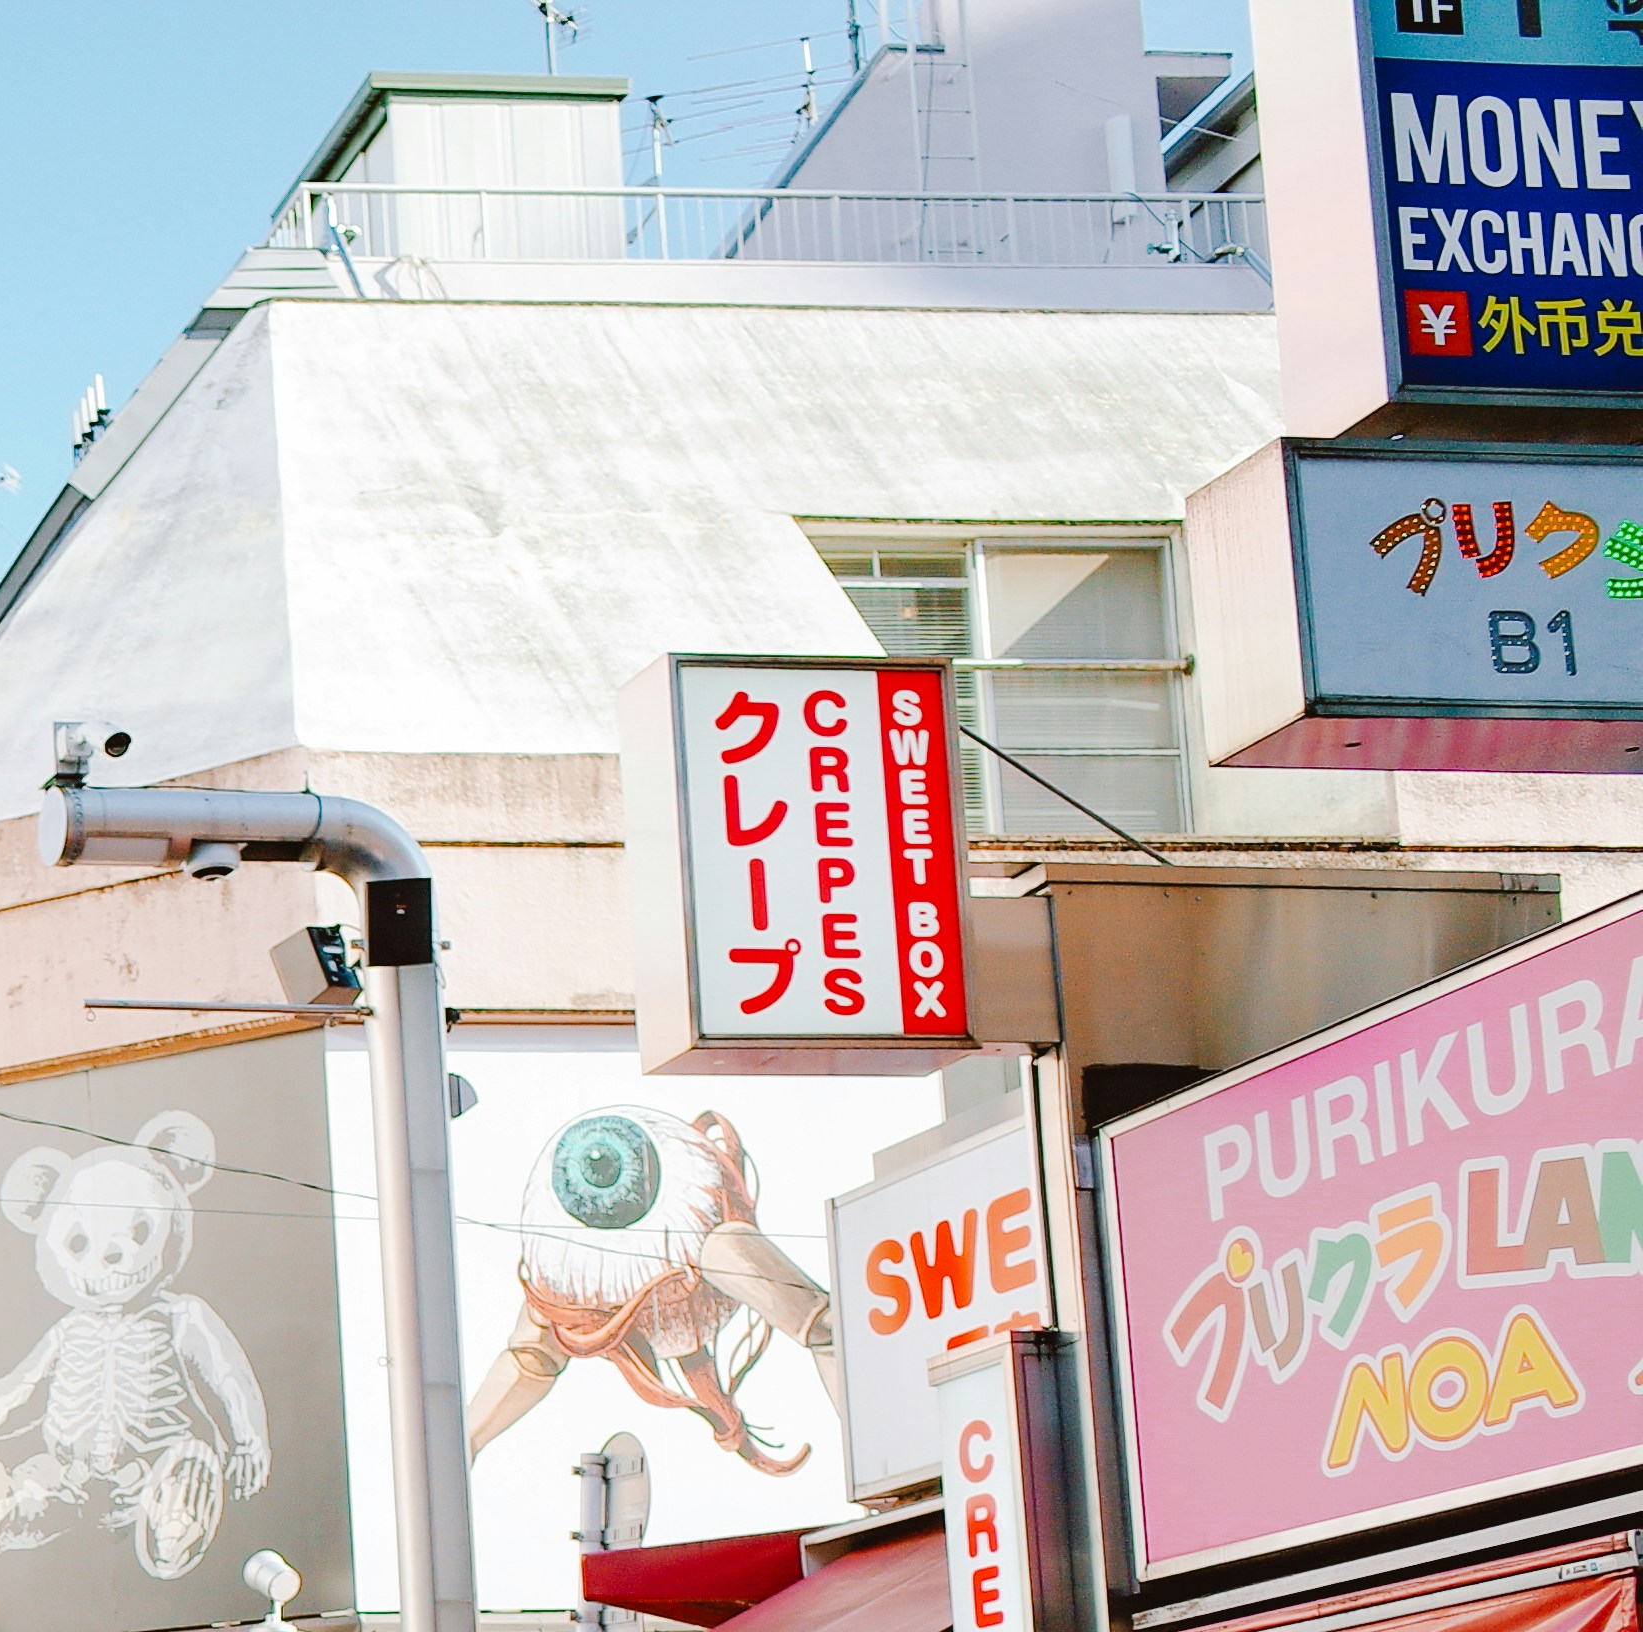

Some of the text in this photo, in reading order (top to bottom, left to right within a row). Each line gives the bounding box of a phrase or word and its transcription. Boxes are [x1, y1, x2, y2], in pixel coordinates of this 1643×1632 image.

[1389, 92, 1643, 190] MONE
[1487, 609, 1577, 677] B1
[715, 690, 802, 1015] クレープ
[803, 690, 865, 1016] CREPES
[888, 689, 947, 1018] SWEET BOX
[1165, 1183, 1450, 1418] プリクラ
[1324, 1306, 1582, 1477] NOA
